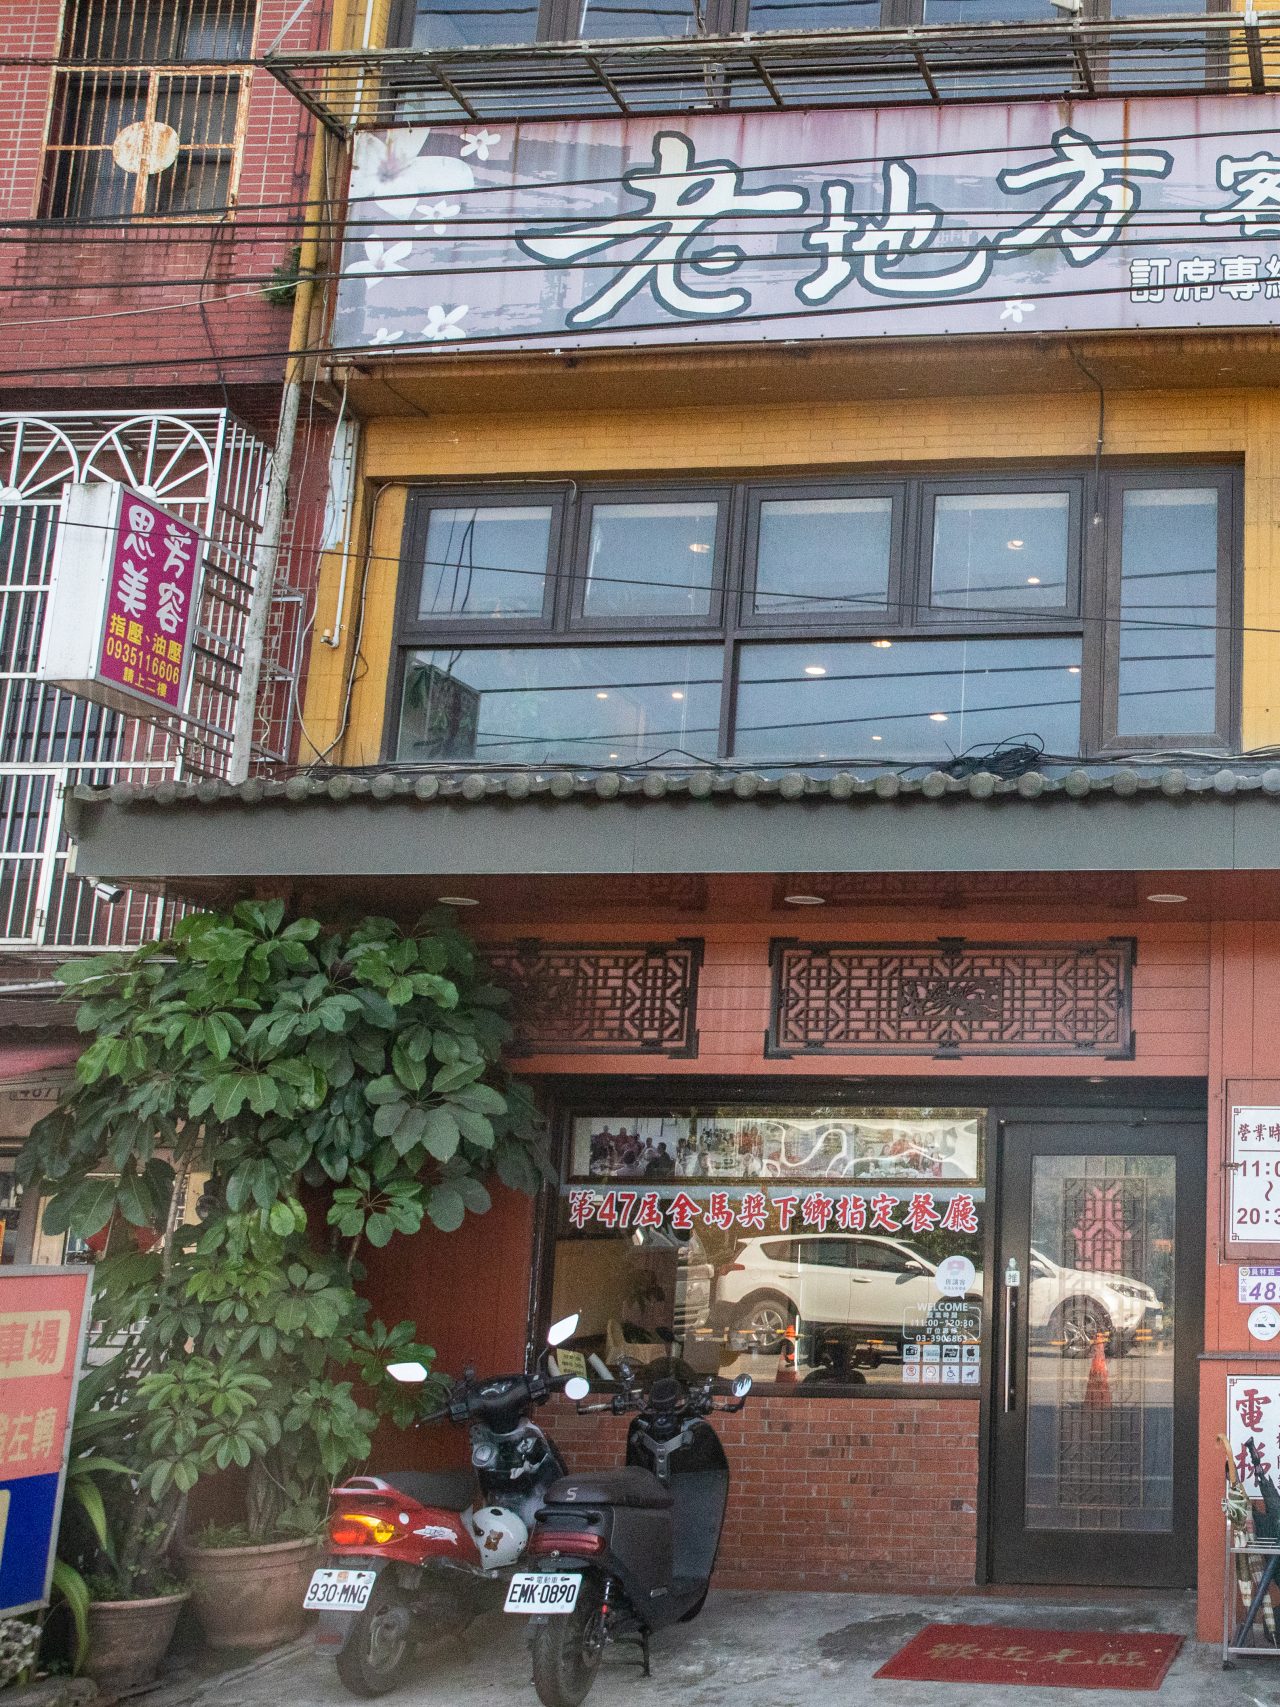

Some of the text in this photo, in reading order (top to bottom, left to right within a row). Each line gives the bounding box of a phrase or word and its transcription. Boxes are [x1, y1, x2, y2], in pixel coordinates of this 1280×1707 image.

[515, 127, 1173, 330] 老地方
[106, 636, 180, 685] 0935116606
[569, 1190, 979, 1233] 第47屆金馬獎下鄉指定餐廳
[917, 1303, 968, 1311] WELCOME
